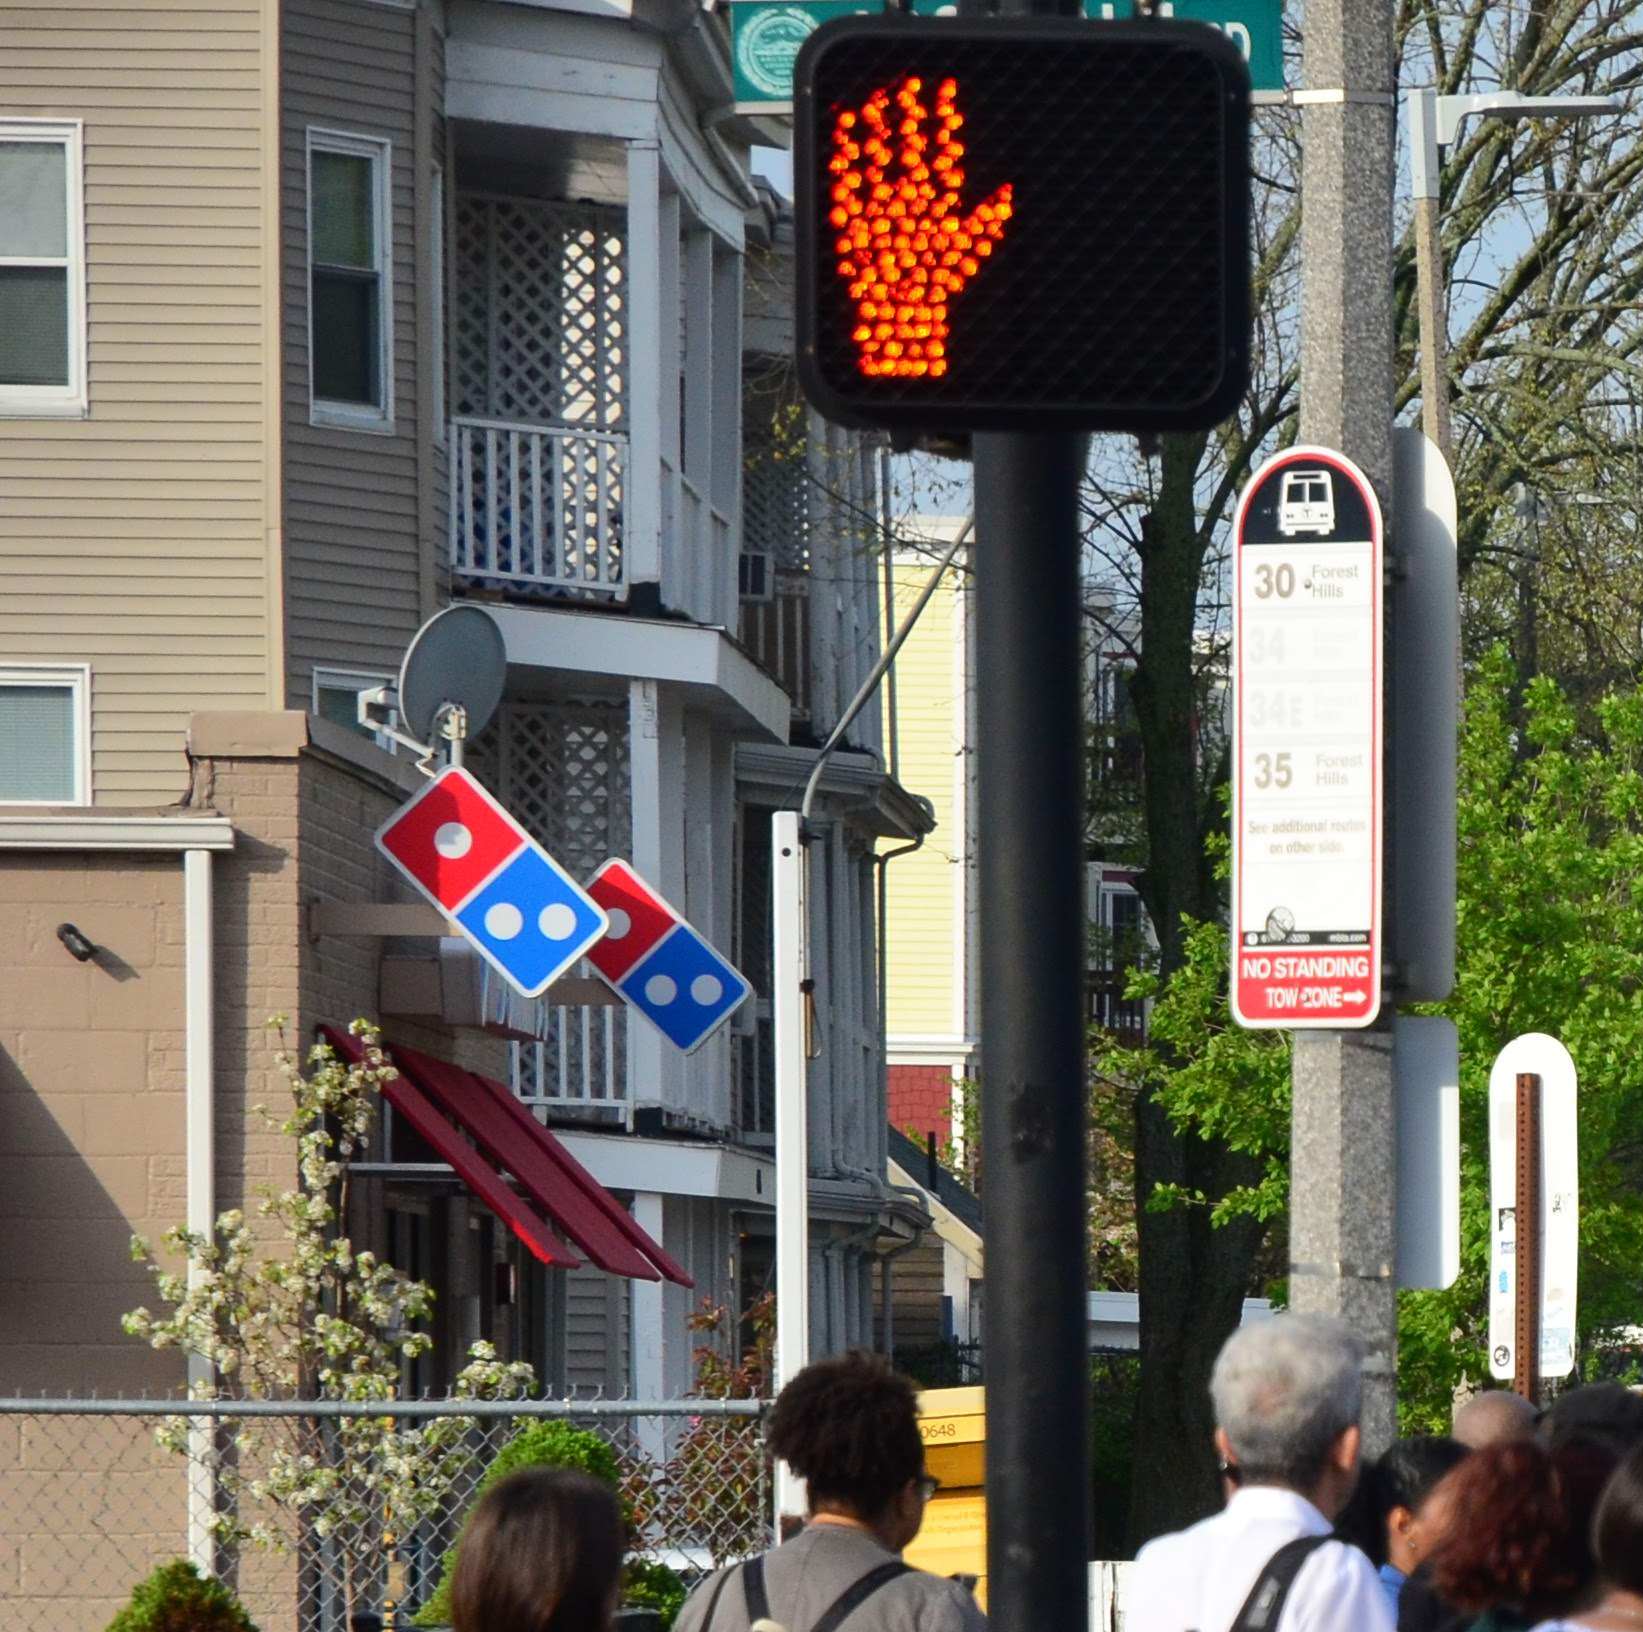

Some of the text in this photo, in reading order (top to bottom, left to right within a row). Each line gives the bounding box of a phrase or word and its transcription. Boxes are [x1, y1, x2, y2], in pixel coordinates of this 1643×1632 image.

[1312, 564, 1359, 578] Forest
[1254, 563, 1296, 599] 30
[1312, 584, 1344, 598] Hills
[1315, 753, 1363, 767] Forest
[1254, 752, 1293, 789] 35
[1316, 772, 1349, 785] Hills
[1271, 819, 1327, 833] additional
[1243, 957, 1369, 979] NO STANDING
